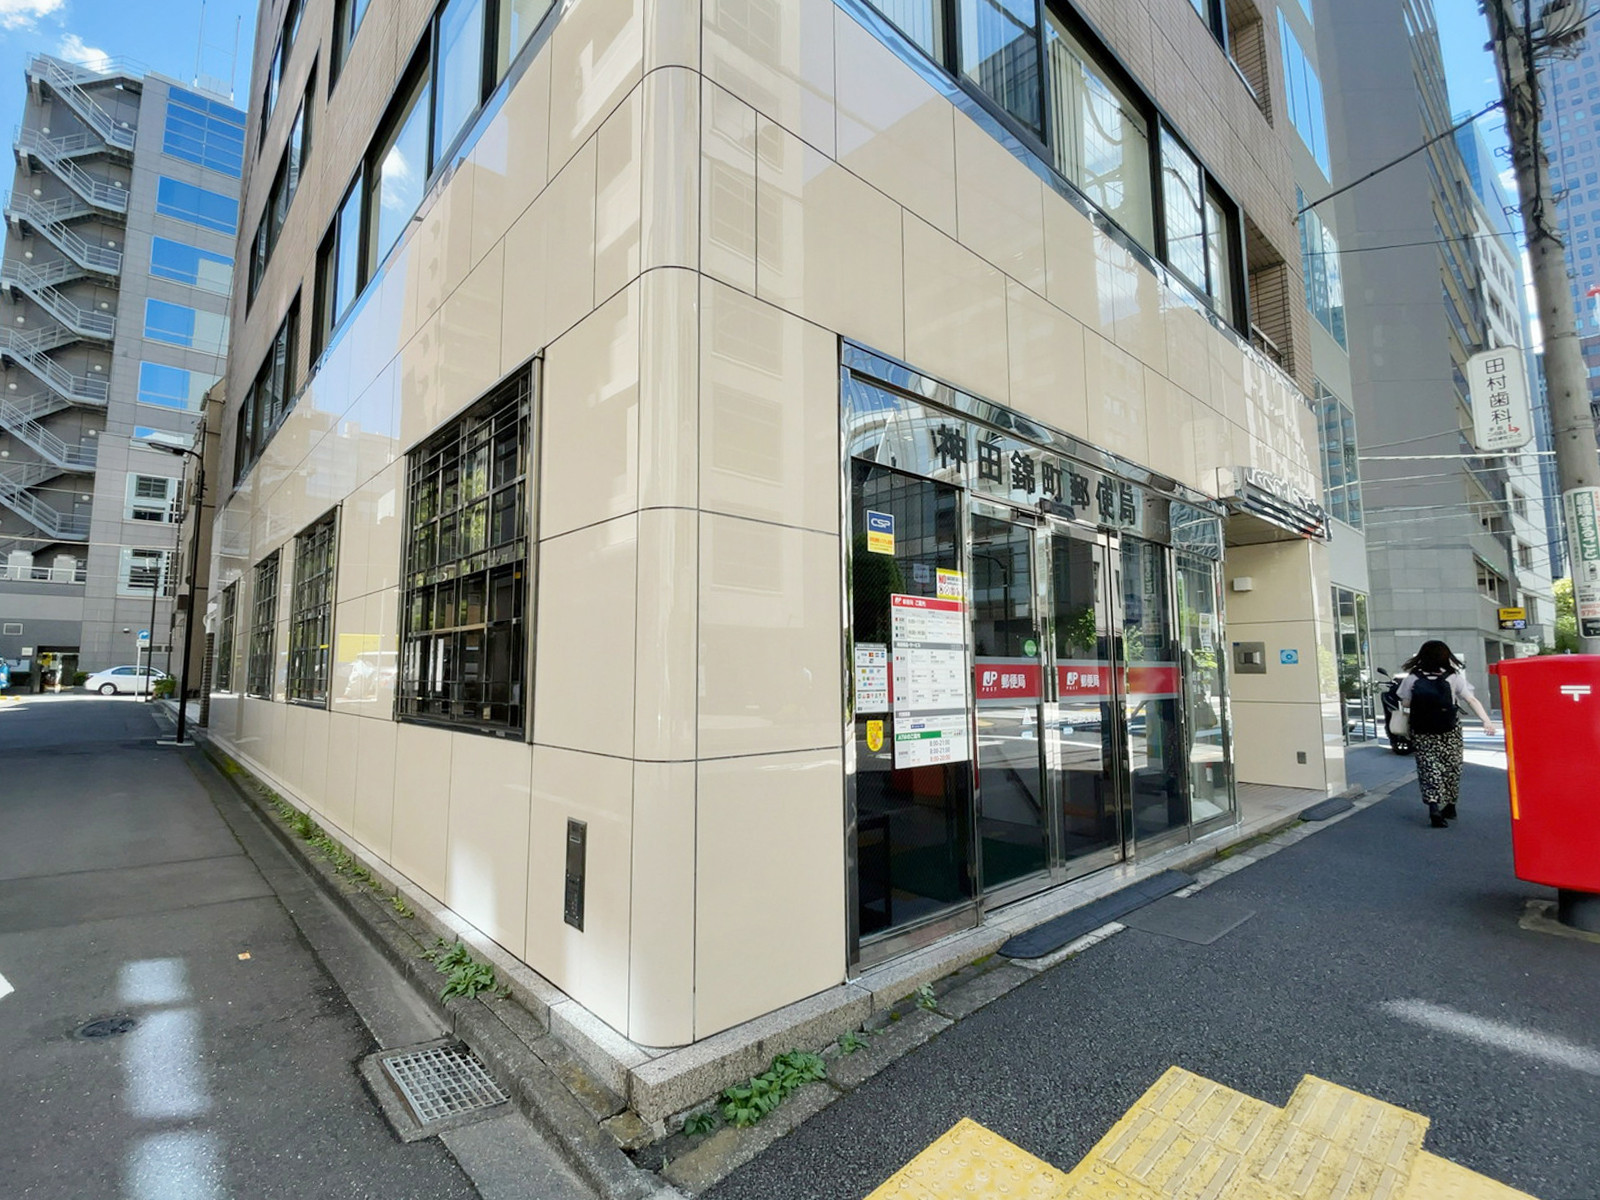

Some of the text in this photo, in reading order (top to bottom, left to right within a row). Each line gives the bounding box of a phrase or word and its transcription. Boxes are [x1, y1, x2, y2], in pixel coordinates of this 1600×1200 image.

[1485, 357, 1512, 425] 田村歯科
[934, 423, 1136, 526] 神田錦町郵便局
[870, 517, 891, 529] CSP
[1001, 673, 1026, 689] 郵便局
[1081, 674, 1100, 688] 郵便局
